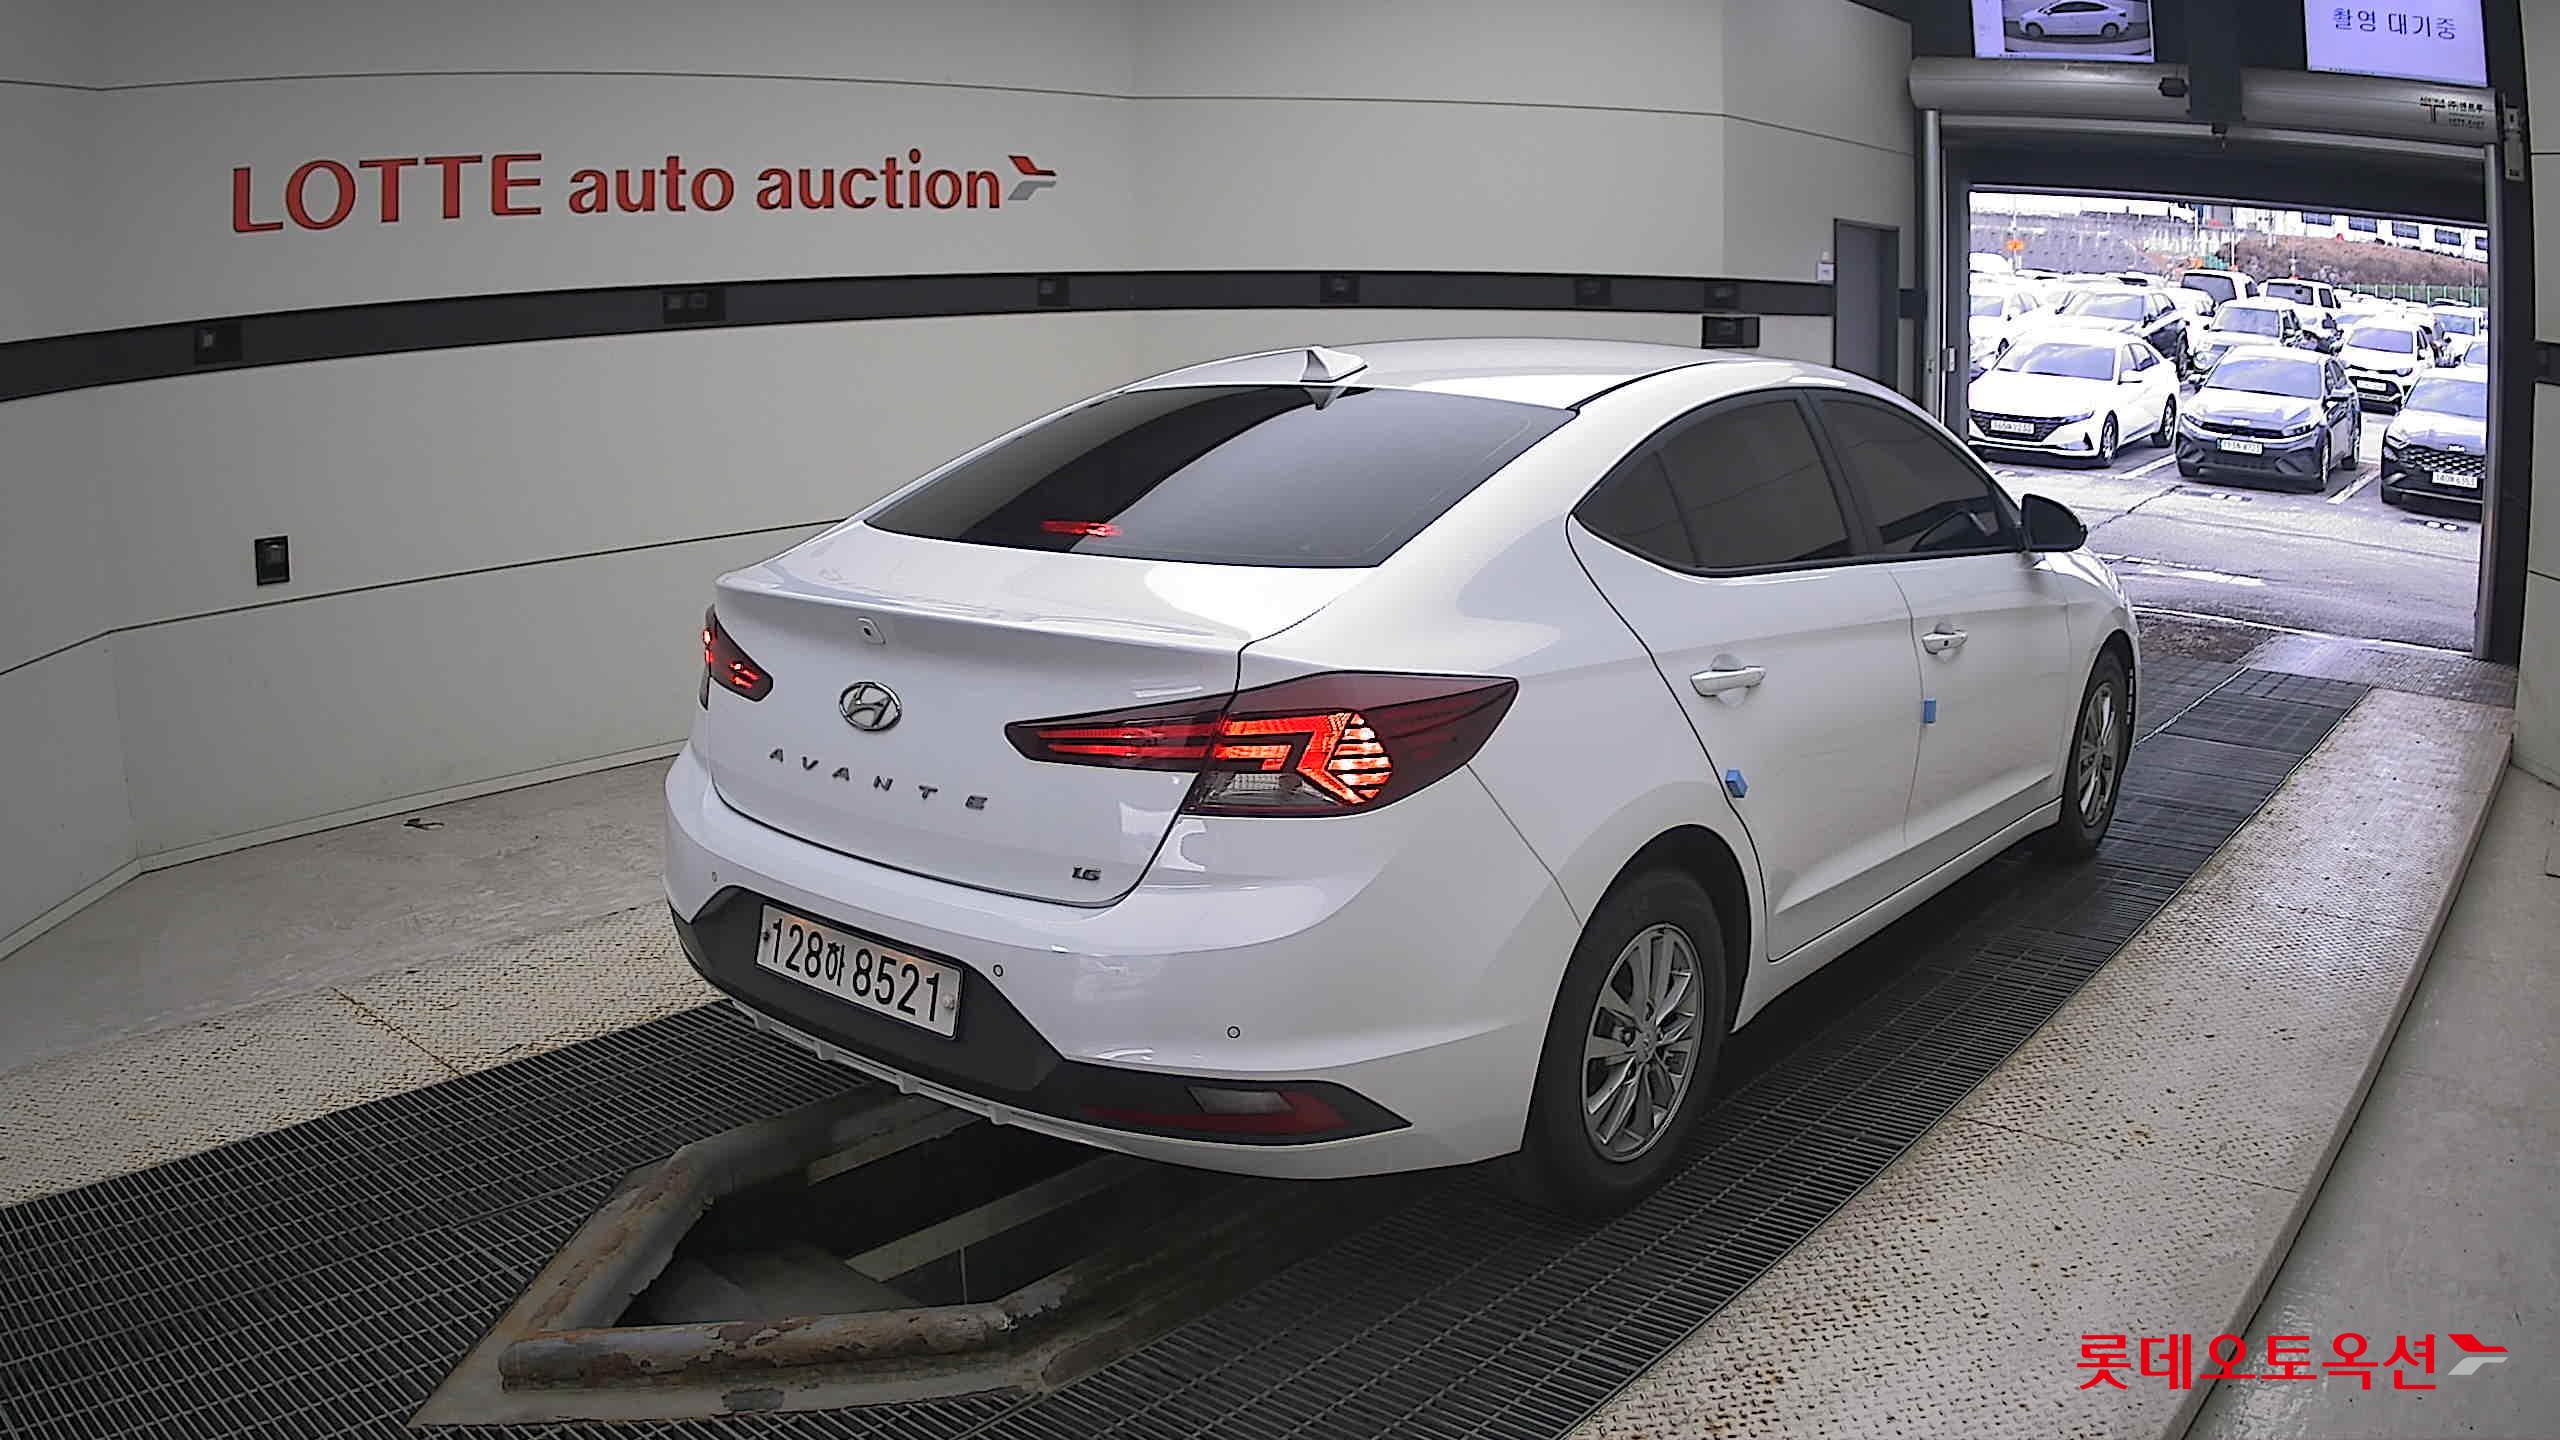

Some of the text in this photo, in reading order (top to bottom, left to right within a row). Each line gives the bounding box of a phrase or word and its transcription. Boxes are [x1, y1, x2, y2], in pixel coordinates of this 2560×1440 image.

[2334, 8, 2456, 40] 촬영 대기중
[233, 148, 1002, 232] LOTTE auto auction
[769, 748, 988, 811] AVANTE
